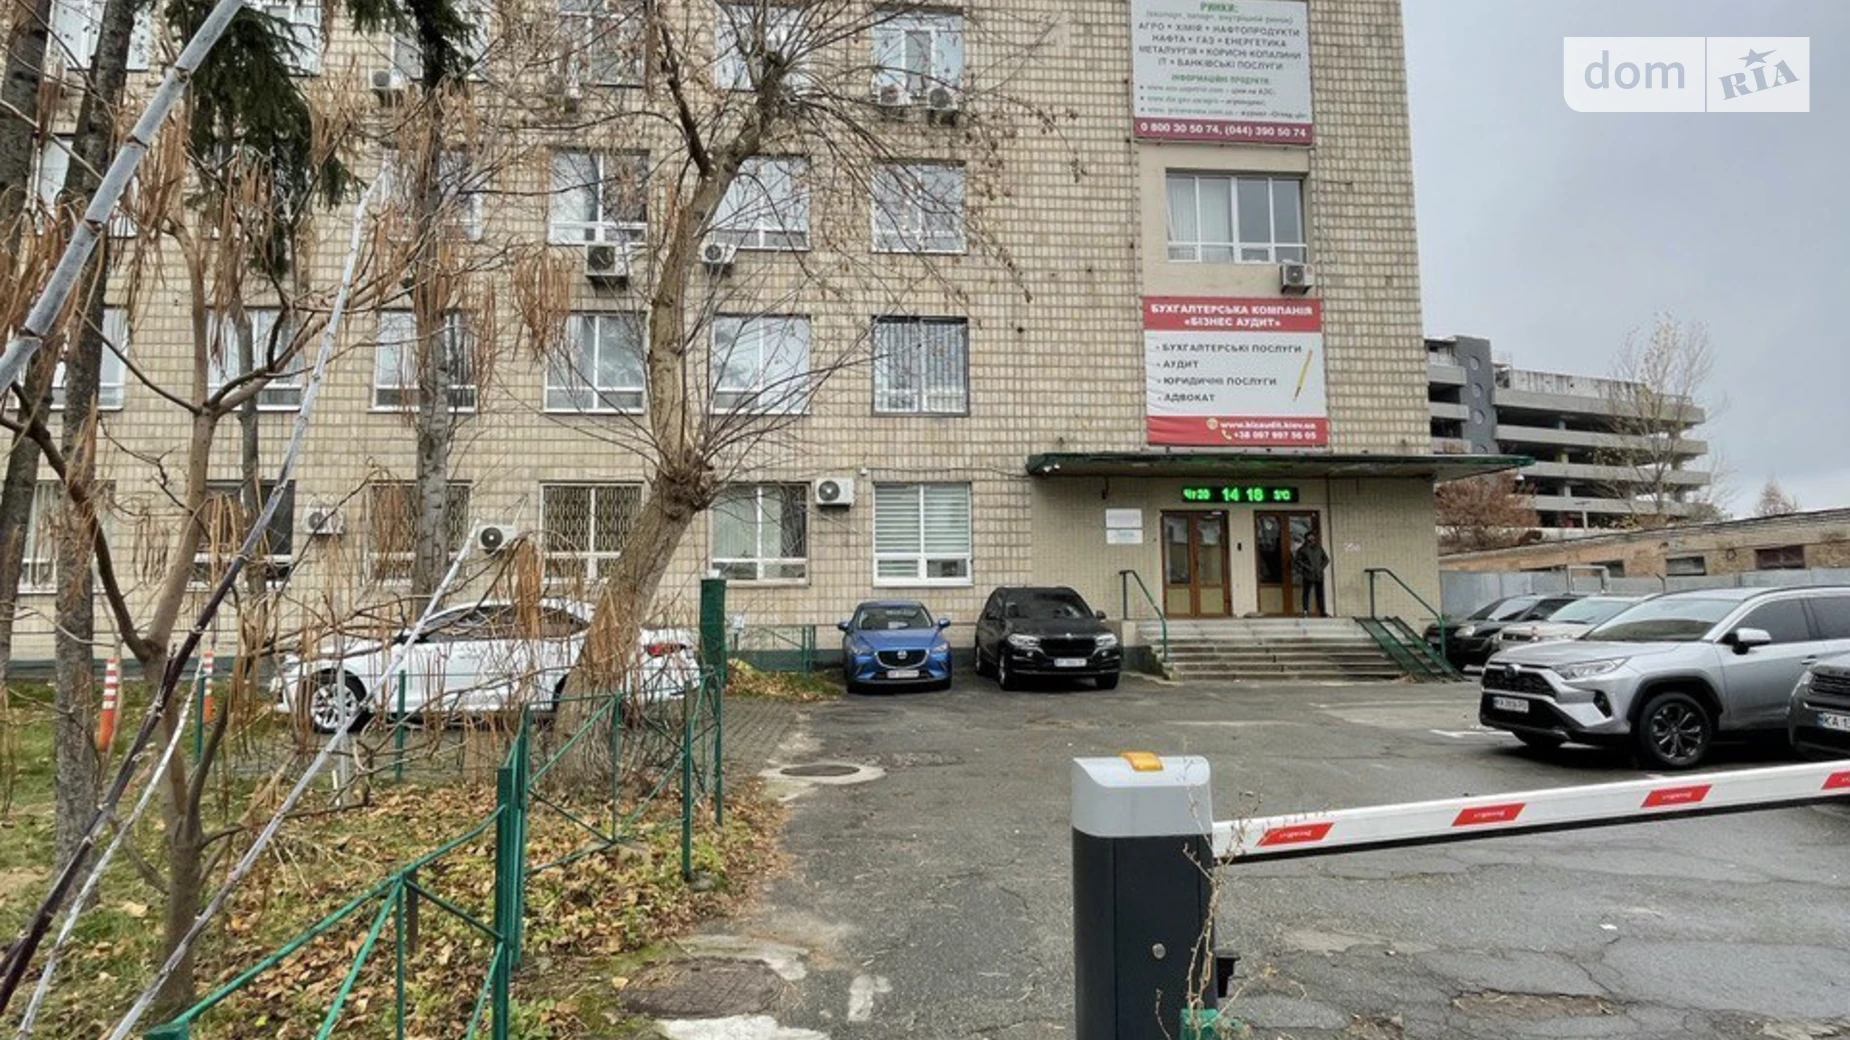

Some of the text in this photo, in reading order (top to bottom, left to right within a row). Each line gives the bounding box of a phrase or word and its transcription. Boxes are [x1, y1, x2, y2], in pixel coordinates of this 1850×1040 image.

[1138, 22, 1300, 37] АГРО ХІМІЯ НАФТОПРОДУКТИ
[1152, 34, 1287, 48] НАФТА ГАЗ ЕНЕРГЕТИКА
[1138, 45, 1301, 60] МЕТАЛУРГІЯ КОРИСНІ КОПАЛИНИ
[1177, 59, 1236, 69] БАНКІВСЬКІ
[1237, 60, 1284, 71] ПОСЛУГИ
[1140, 122, 1148, 132] 0
[1151, 123, 1171, 132] 800
[1173, 123, 1187, 133] 30
[1190, 125, 1203, 134] 50
[1225, 126, 1253, 137] (044)
[1255, 126, 1274, 136] 390
[1277, 128, 1290, 137] 50
[1293, 129, 1306, 137] 74
[1151, 304, 1313, 316] БУХГАЛТЕРСЬКА КОМПАНІЯ
[1184, 317, 1281, 328] «БІЗНЕС АУДИТ»
[1162, 343, 1302, 353] БУХГАЛТЕРСЬКІ ПОСЛУГИ
[1163, 360, 1199, 369] АУДИТ
[1164, 377, 1277, 386] ЮРИДИЧНІ ПОСЛУГИ
[1164, 393, 1215, 402] АДВОКАТ
[1222, 487, 1239, 501] 14
